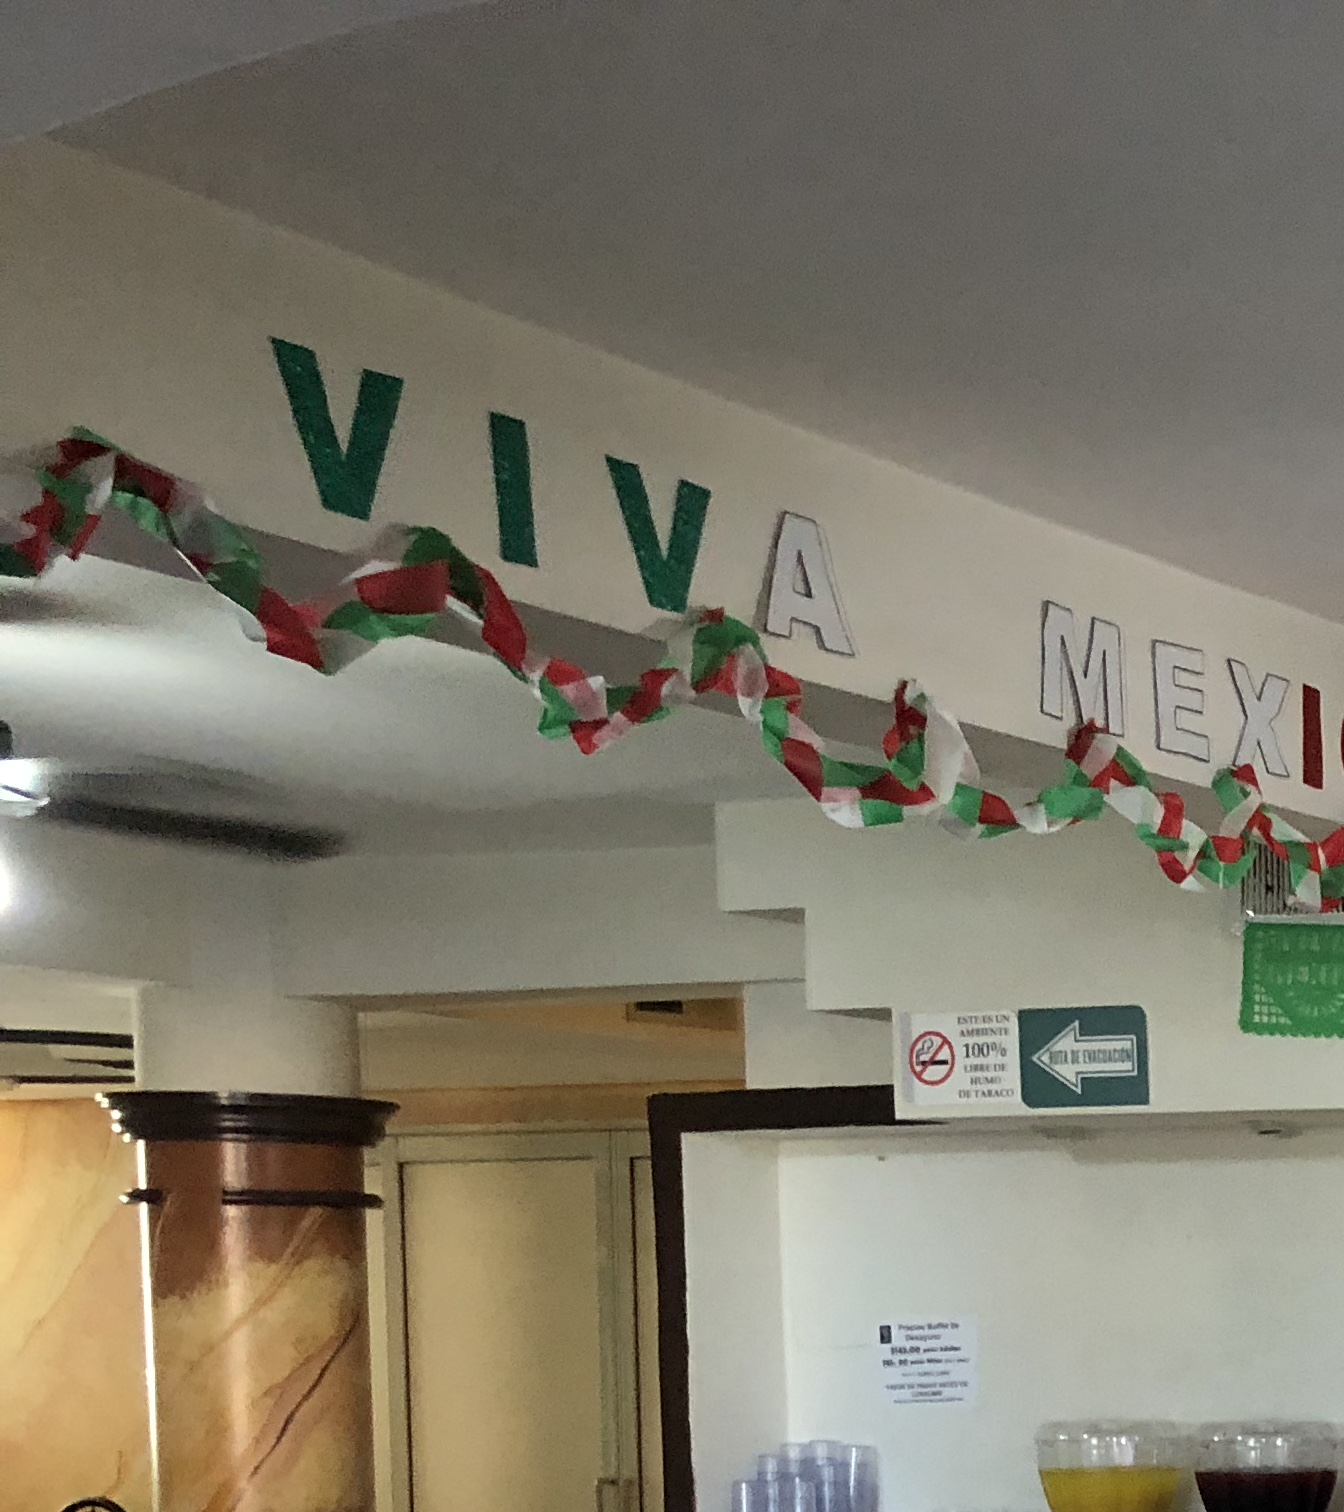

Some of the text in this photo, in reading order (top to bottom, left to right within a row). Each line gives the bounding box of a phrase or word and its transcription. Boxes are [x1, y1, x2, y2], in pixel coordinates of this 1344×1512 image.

[269, 336, 857, 658] VIVA
[957, 1015, 1010, 1025] ESTE ES UN
[959, 1028, 1010, 1037] AMBIENTE
[962, 1042, 1007, 1058] 100%
[1049, 1050, 1068, 1064] RUTA
[1071, 1049, 1079, 1064] DE
[964, 1063, 1007, 1073] LIBRE DE
[970, 1077, 1001, 1086] HUMO
[958, 1088, 1014, 1099] DE TABACO
